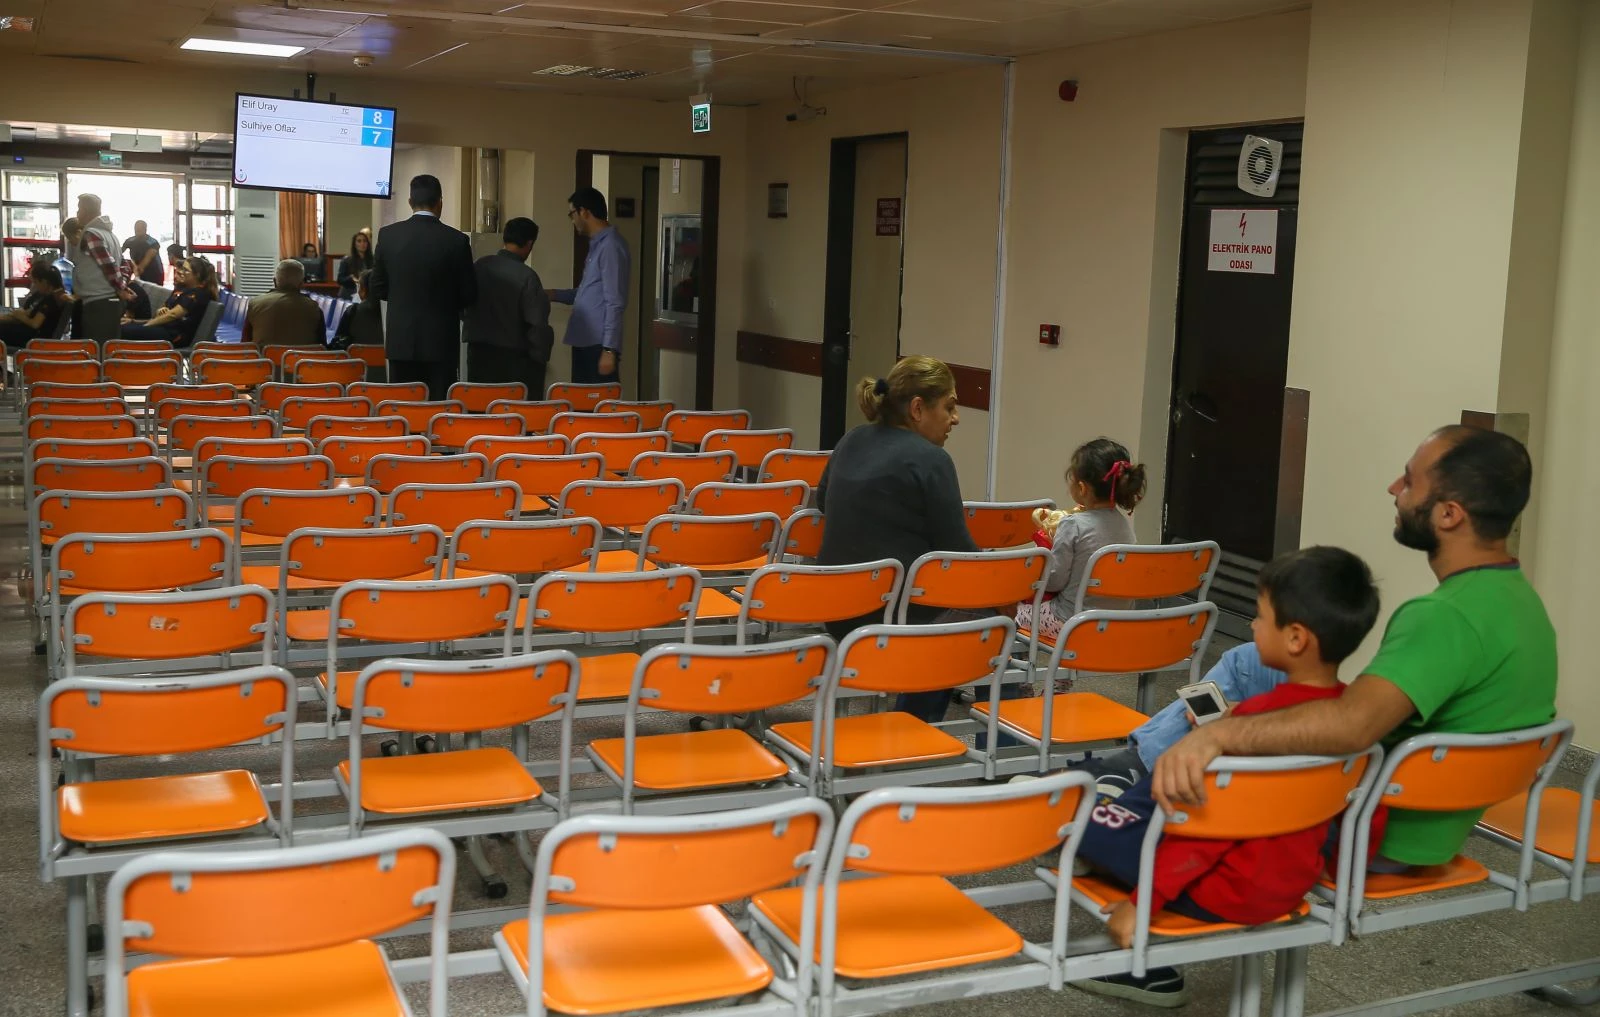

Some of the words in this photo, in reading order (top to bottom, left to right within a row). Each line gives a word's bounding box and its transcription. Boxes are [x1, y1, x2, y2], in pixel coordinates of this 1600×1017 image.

[242, 99, 256, 109] Elif
[257, 102, 278, 113] Uray
[373, 111, 383, 125] 8
[240, 120, 272, 132] Sulhiye
[274, 123, 297, 134] Oflaz
[372, 130, 382, 145] 7
[1212, 242, 1250, 254] ELEKTRİK
[1251, 244, 1273, 255] PANO
[1229, 259, 1253, 270] ODASI
